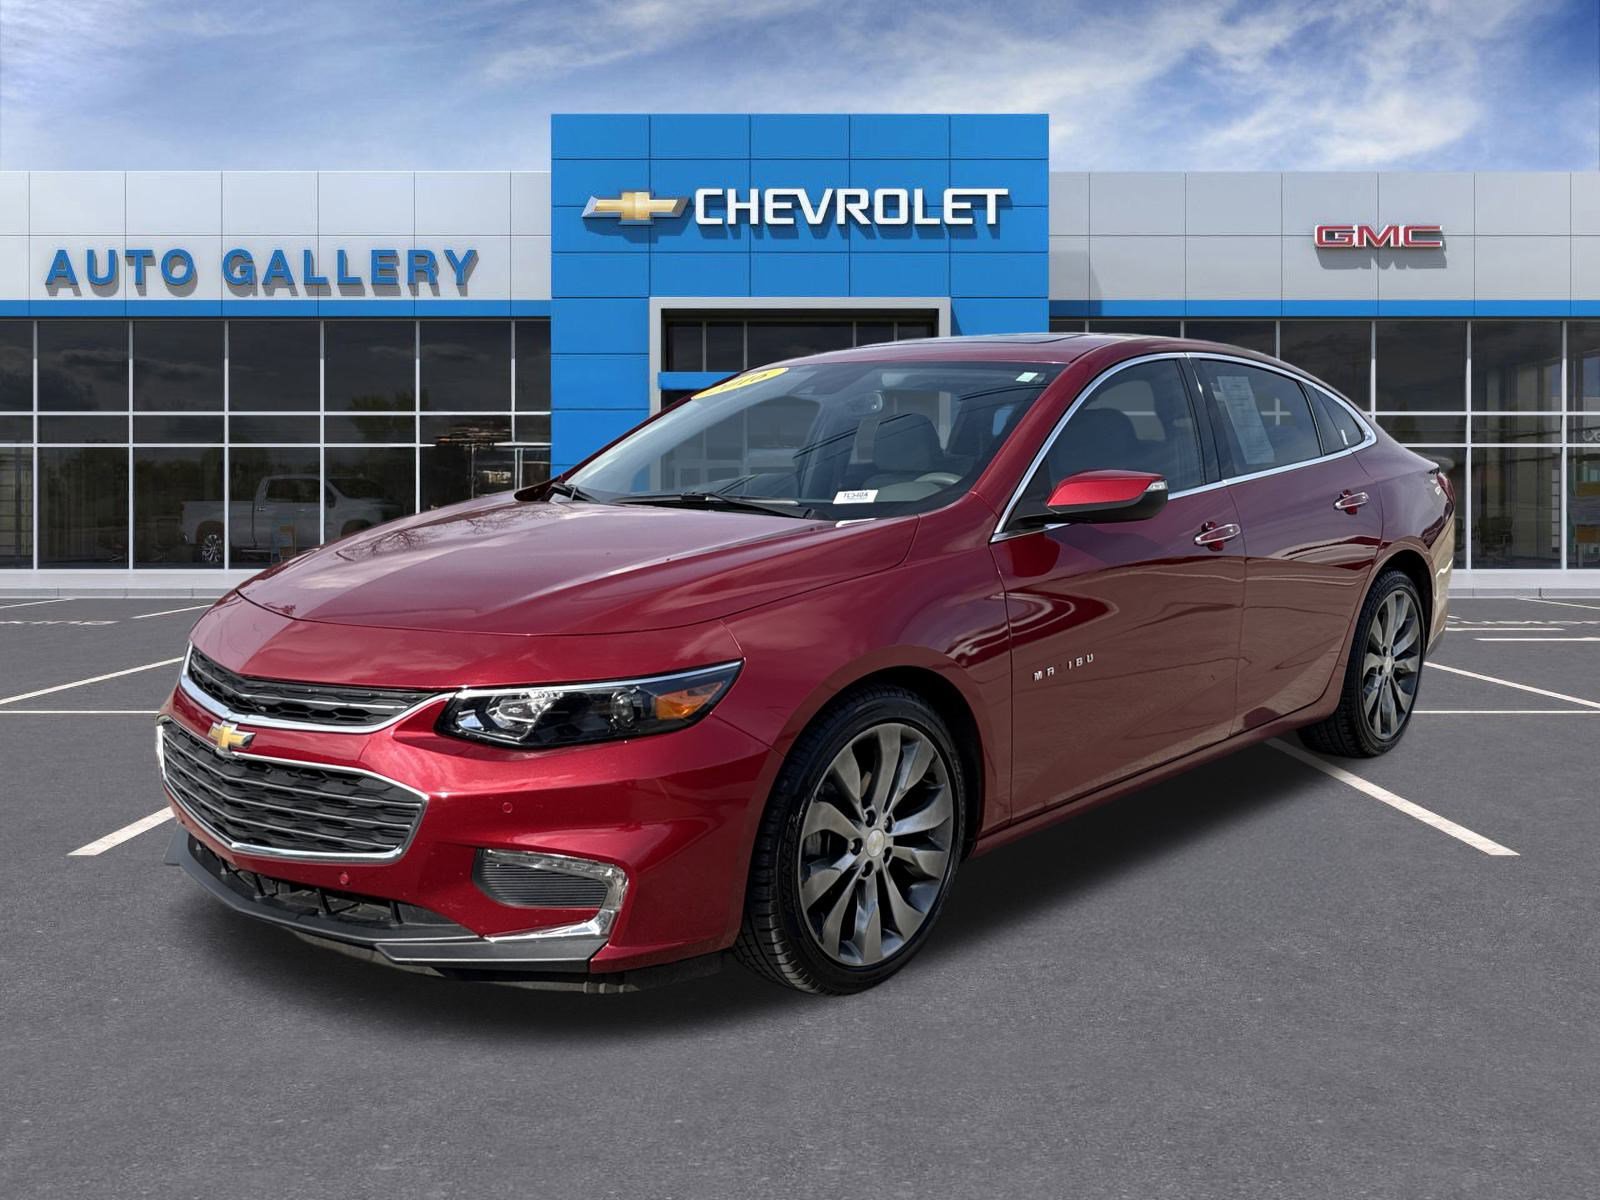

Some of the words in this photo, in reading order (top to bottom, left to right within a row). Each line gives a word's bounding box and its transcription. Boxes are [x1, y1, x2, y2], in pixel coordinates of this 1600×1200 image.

[694, 188, 1009, 225] CHEVROLET
[1314, 225, 1442, 247] GMC
[45, 249, 195, 286] AUTO
[222, 249, 478, 286] GALLERY
